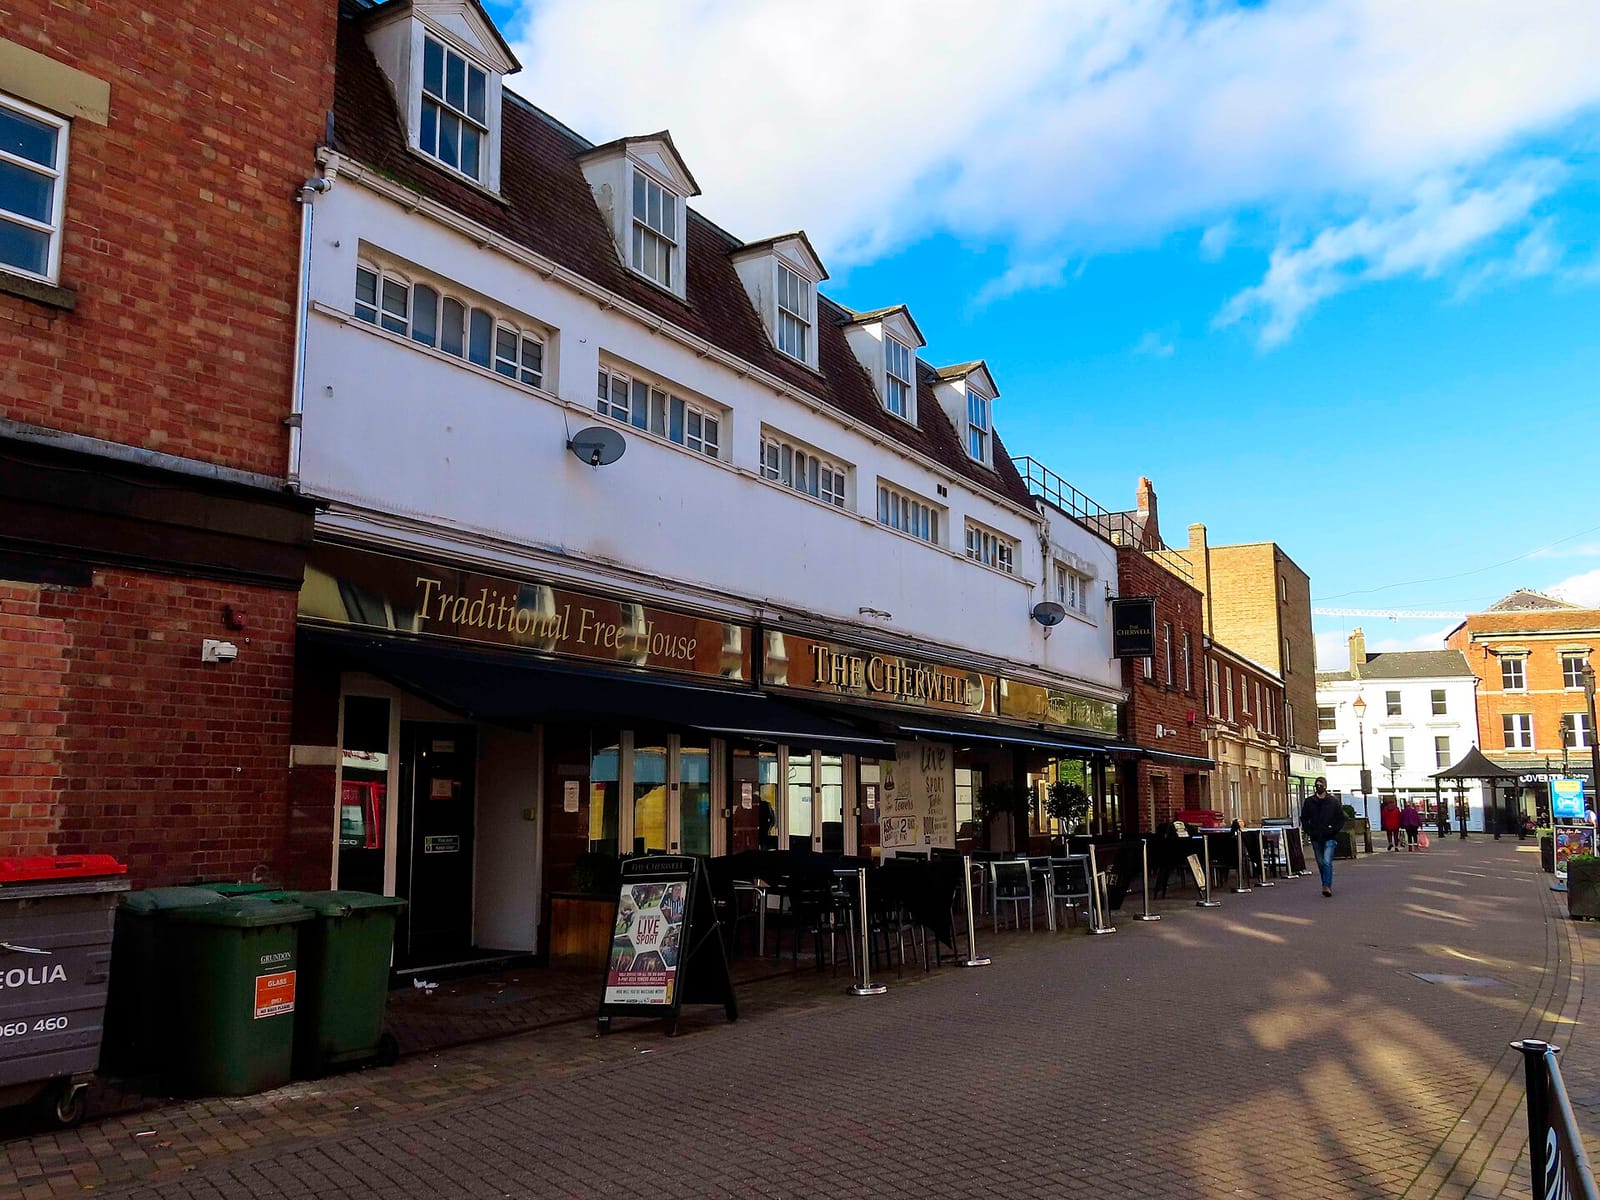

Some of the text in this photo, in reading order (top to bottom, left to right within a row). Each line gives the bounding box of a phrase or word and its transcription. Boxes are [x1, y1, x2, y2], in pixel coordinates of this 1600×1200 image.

[416, 576, 697, 660] Traditional Free House
[900, 819, 907, 833] 2
[637, 919, 660, 935] LIVE
[636, 934, 658, 945] SPORT
[0, 964, 67, 989] OLIA
[268, 978, 287, 988] GLASS
[0, 1016, 68, 1036] 60 460
